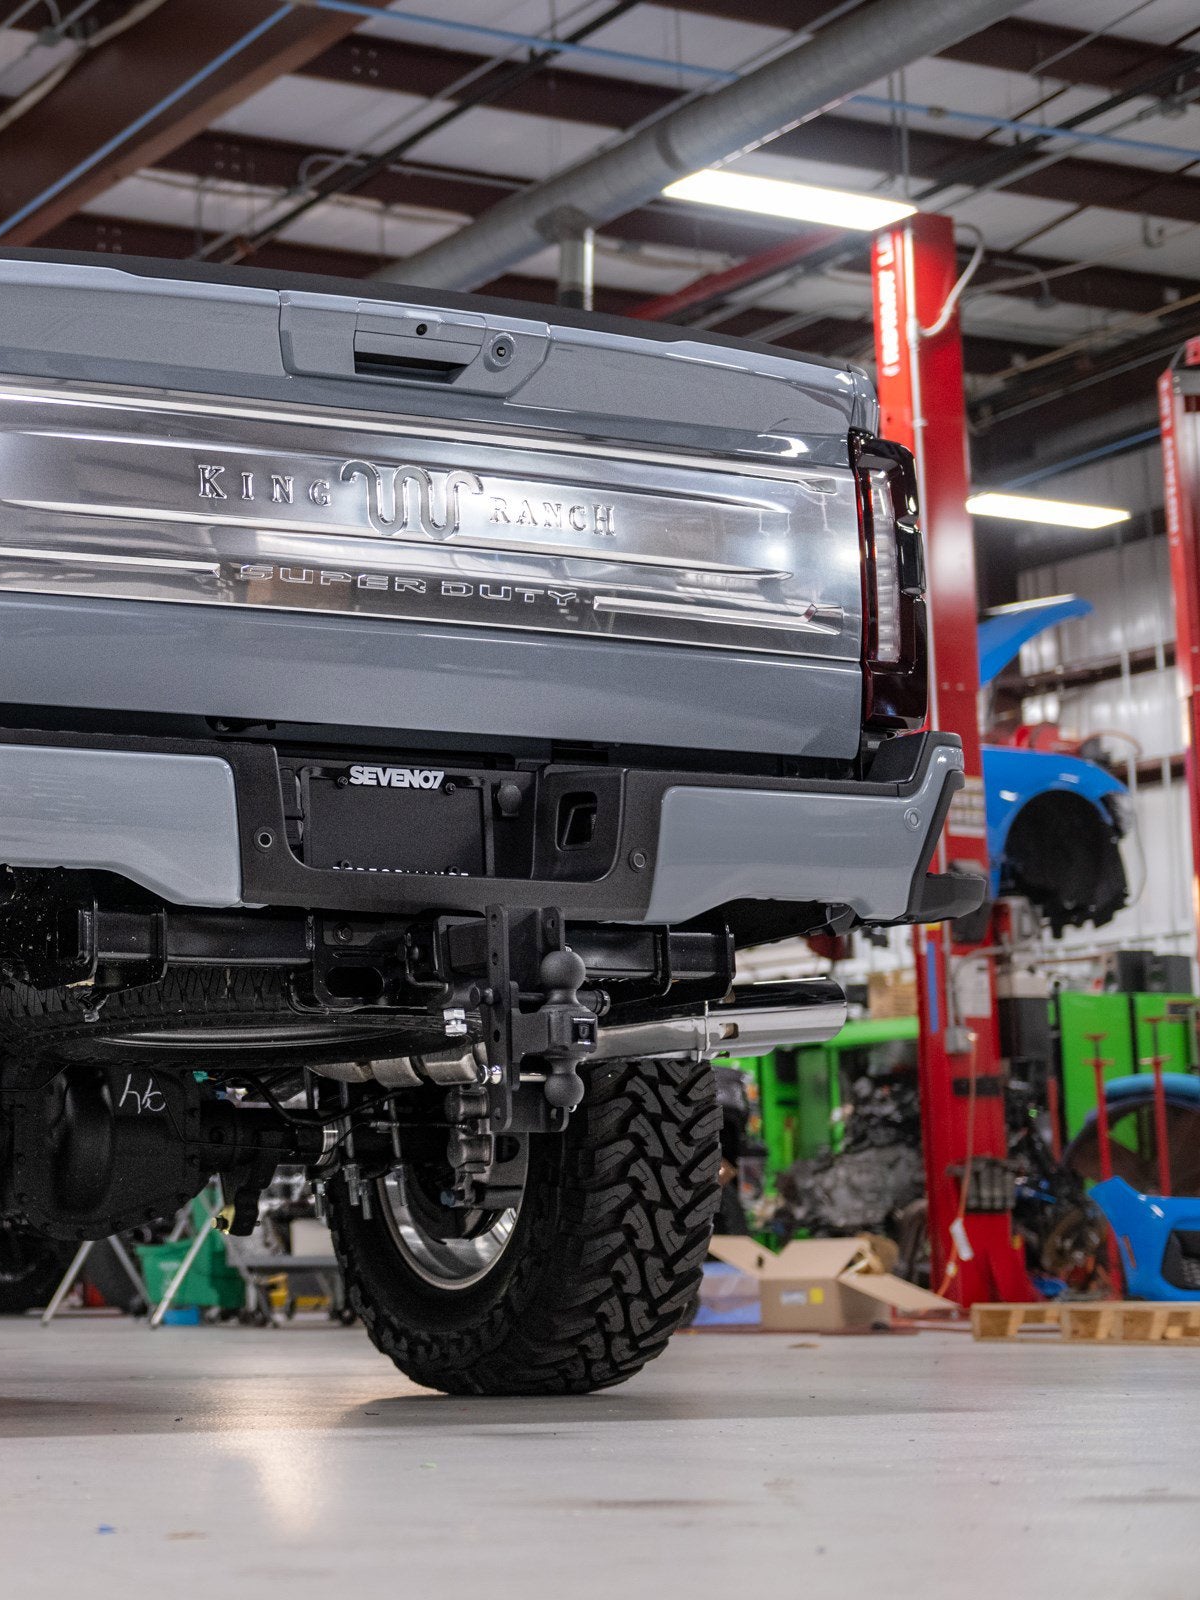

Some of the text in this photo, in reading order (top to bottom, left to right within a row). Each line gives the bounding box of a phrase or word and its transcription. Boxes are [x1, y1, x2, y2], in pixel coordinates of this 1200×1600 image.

[199, 464, 617, 537] KING RANCH
[240, 563, 577, 606] SUPER DUTY
